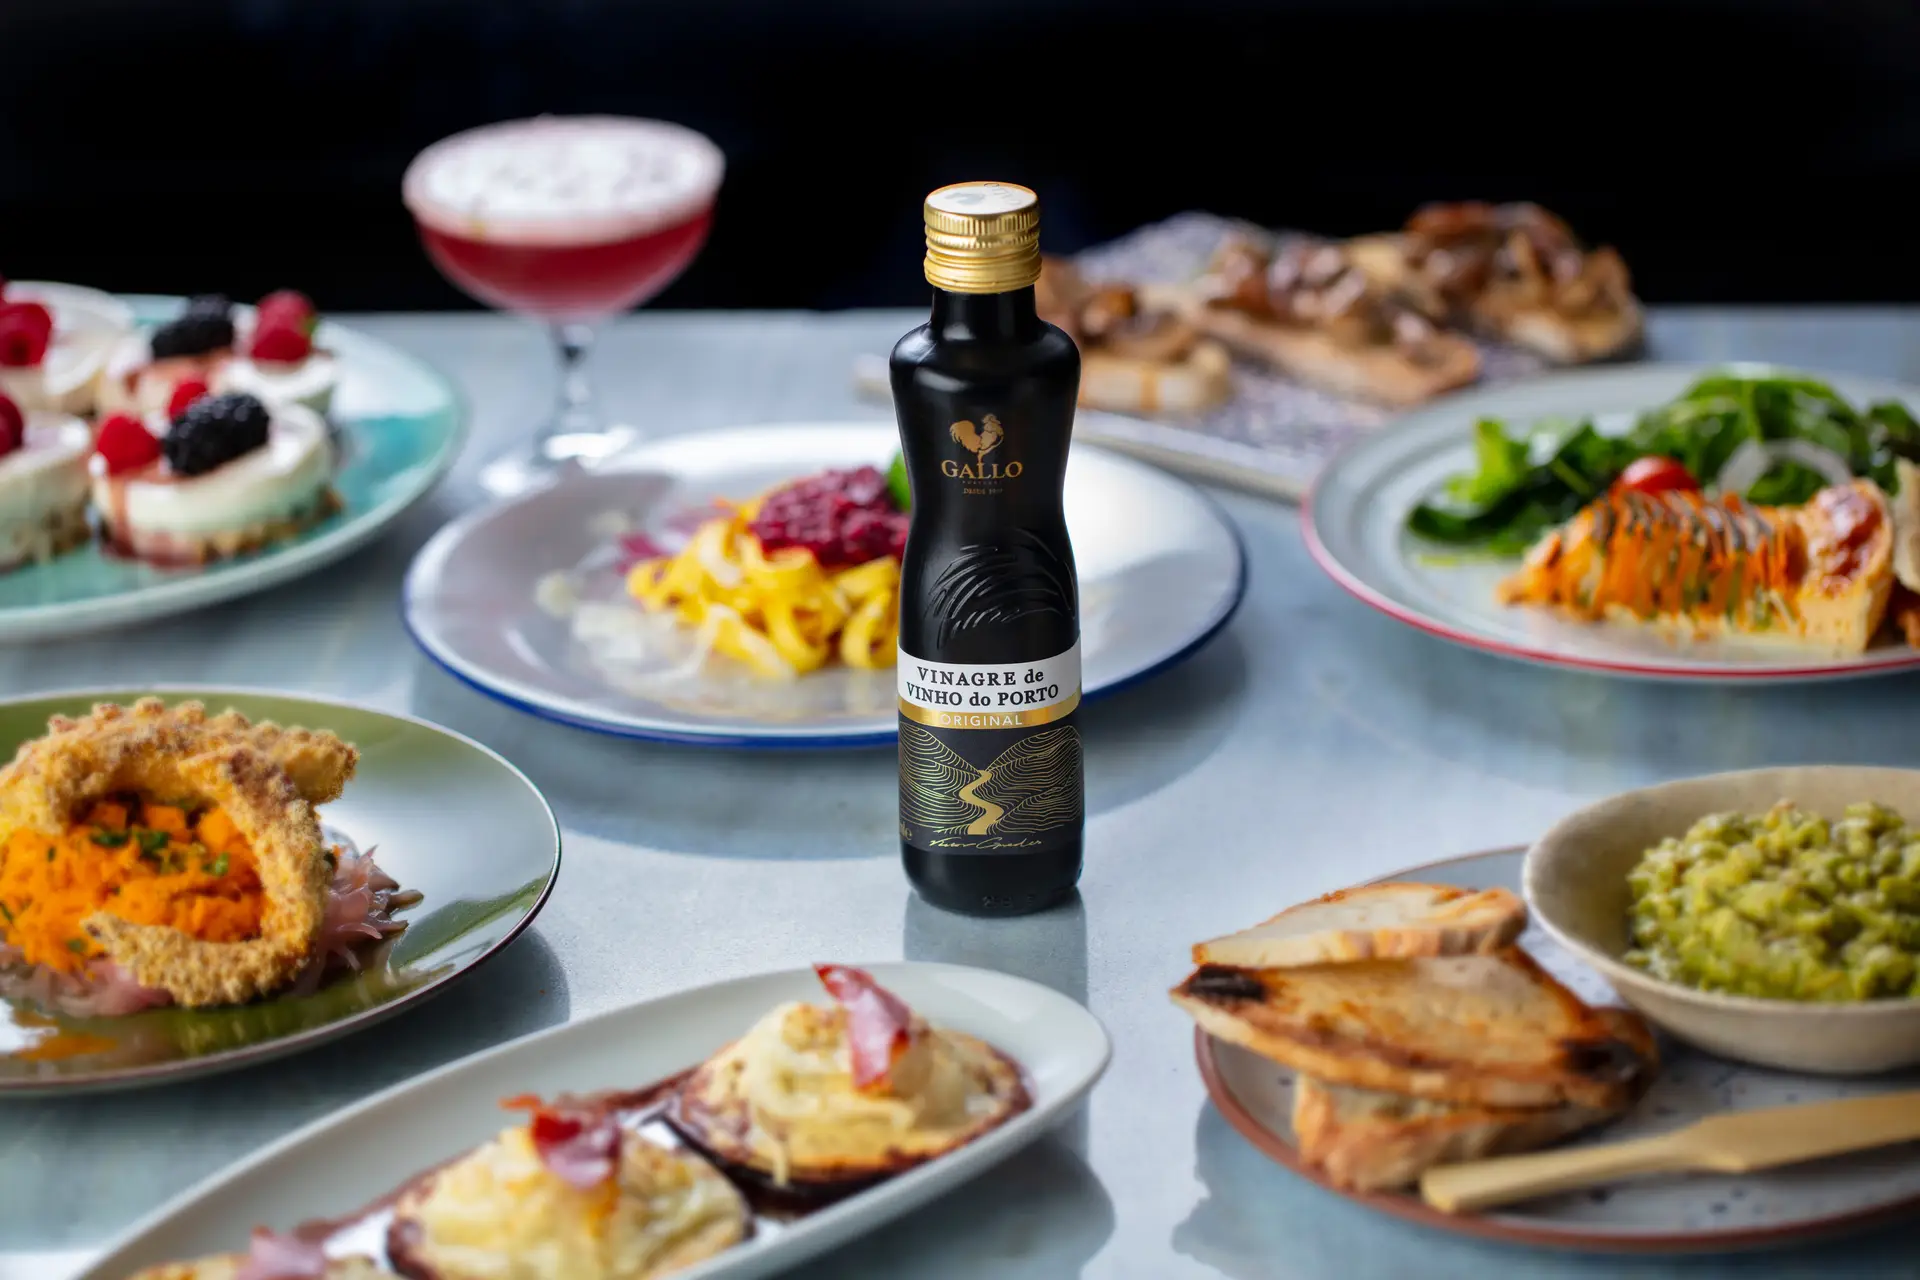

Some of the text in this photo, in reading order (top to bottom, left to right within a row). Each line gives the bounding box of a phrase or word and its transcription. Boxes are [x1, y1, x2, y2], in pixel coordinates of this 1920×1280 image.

[941, 459, 1024, 480] GALLO
[917, 666, 1044, 686] VINAGRE de
[906, 682, 1059, 707] VINHO do PORTO
[940, 713, 1023, 727] ORIGINAL
